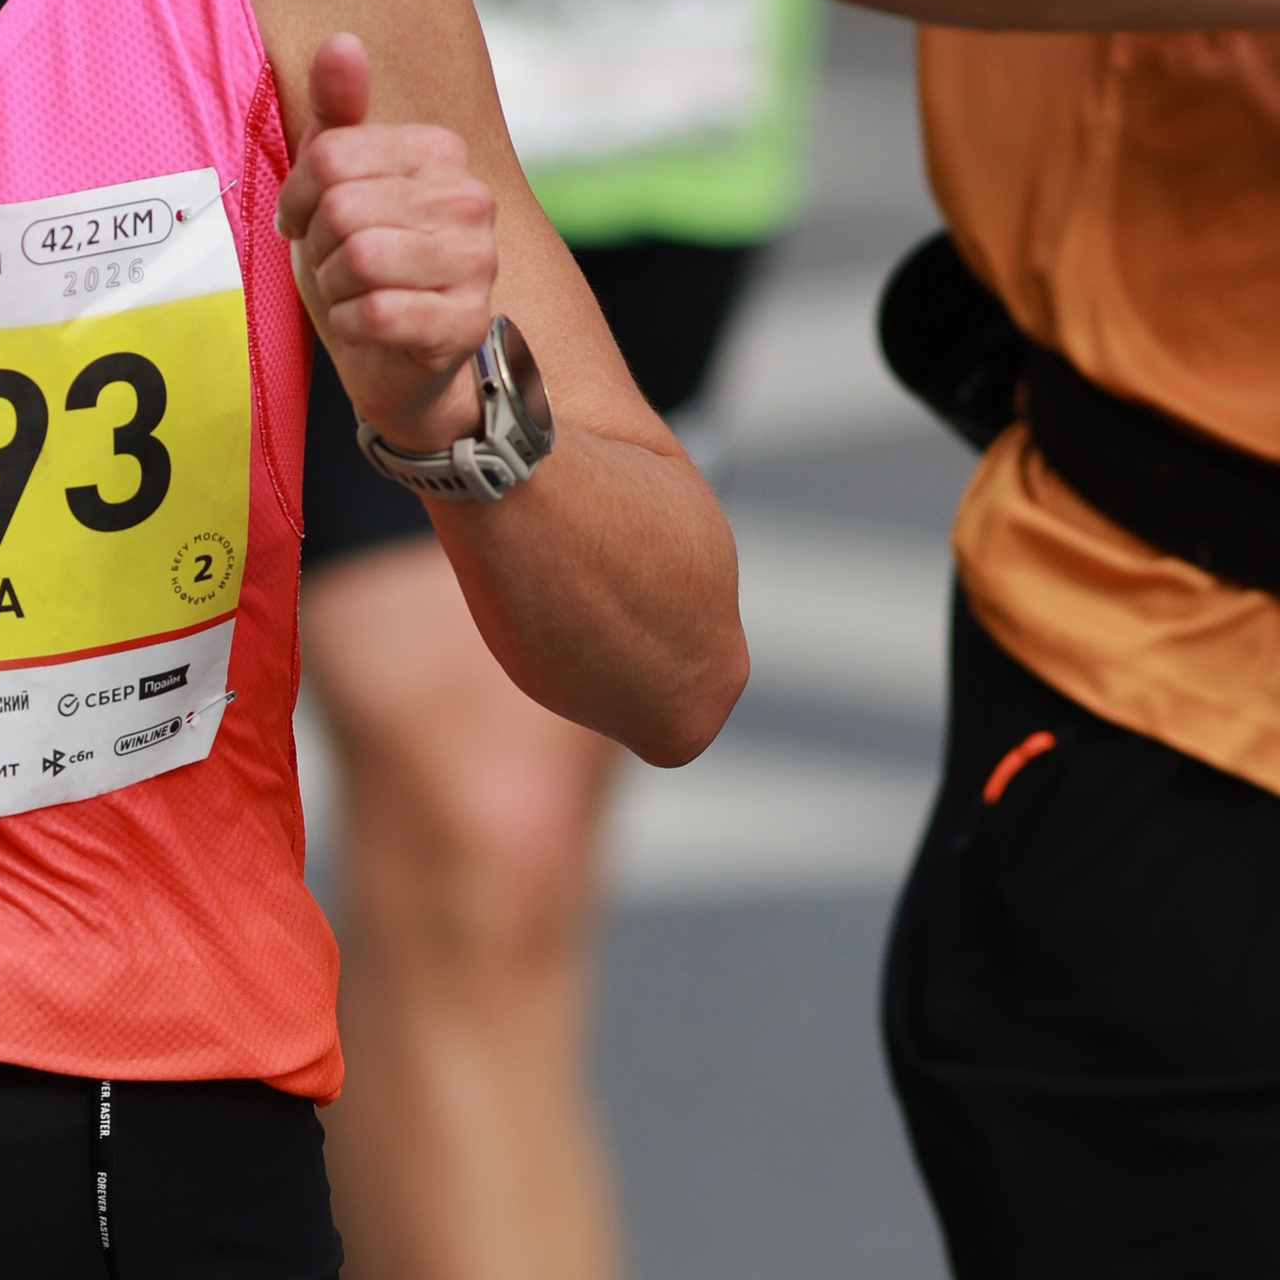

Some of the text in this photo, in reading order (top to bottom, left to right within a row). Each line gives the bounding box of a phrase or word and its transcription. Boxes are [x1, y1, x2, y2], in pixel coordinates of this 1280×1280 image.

[41, 209, 153, 252] 42,2 КМ
[63, 257, 144, 297] 2026
[171, 532, 235, 605] БЕГУ МОСКОВСКИЙ МАРАФОН
[193, 554, 213, 583] 2
[85, 675, 181, 708] СБЕР Прайм
[120, 724, 169, 752] WINLINE
[69, 750, 94, 764] сбп
[99, 1102, 111, 1139] FASTER.
[97, 1172, 110, 1250] FOREVER. FASTER.
